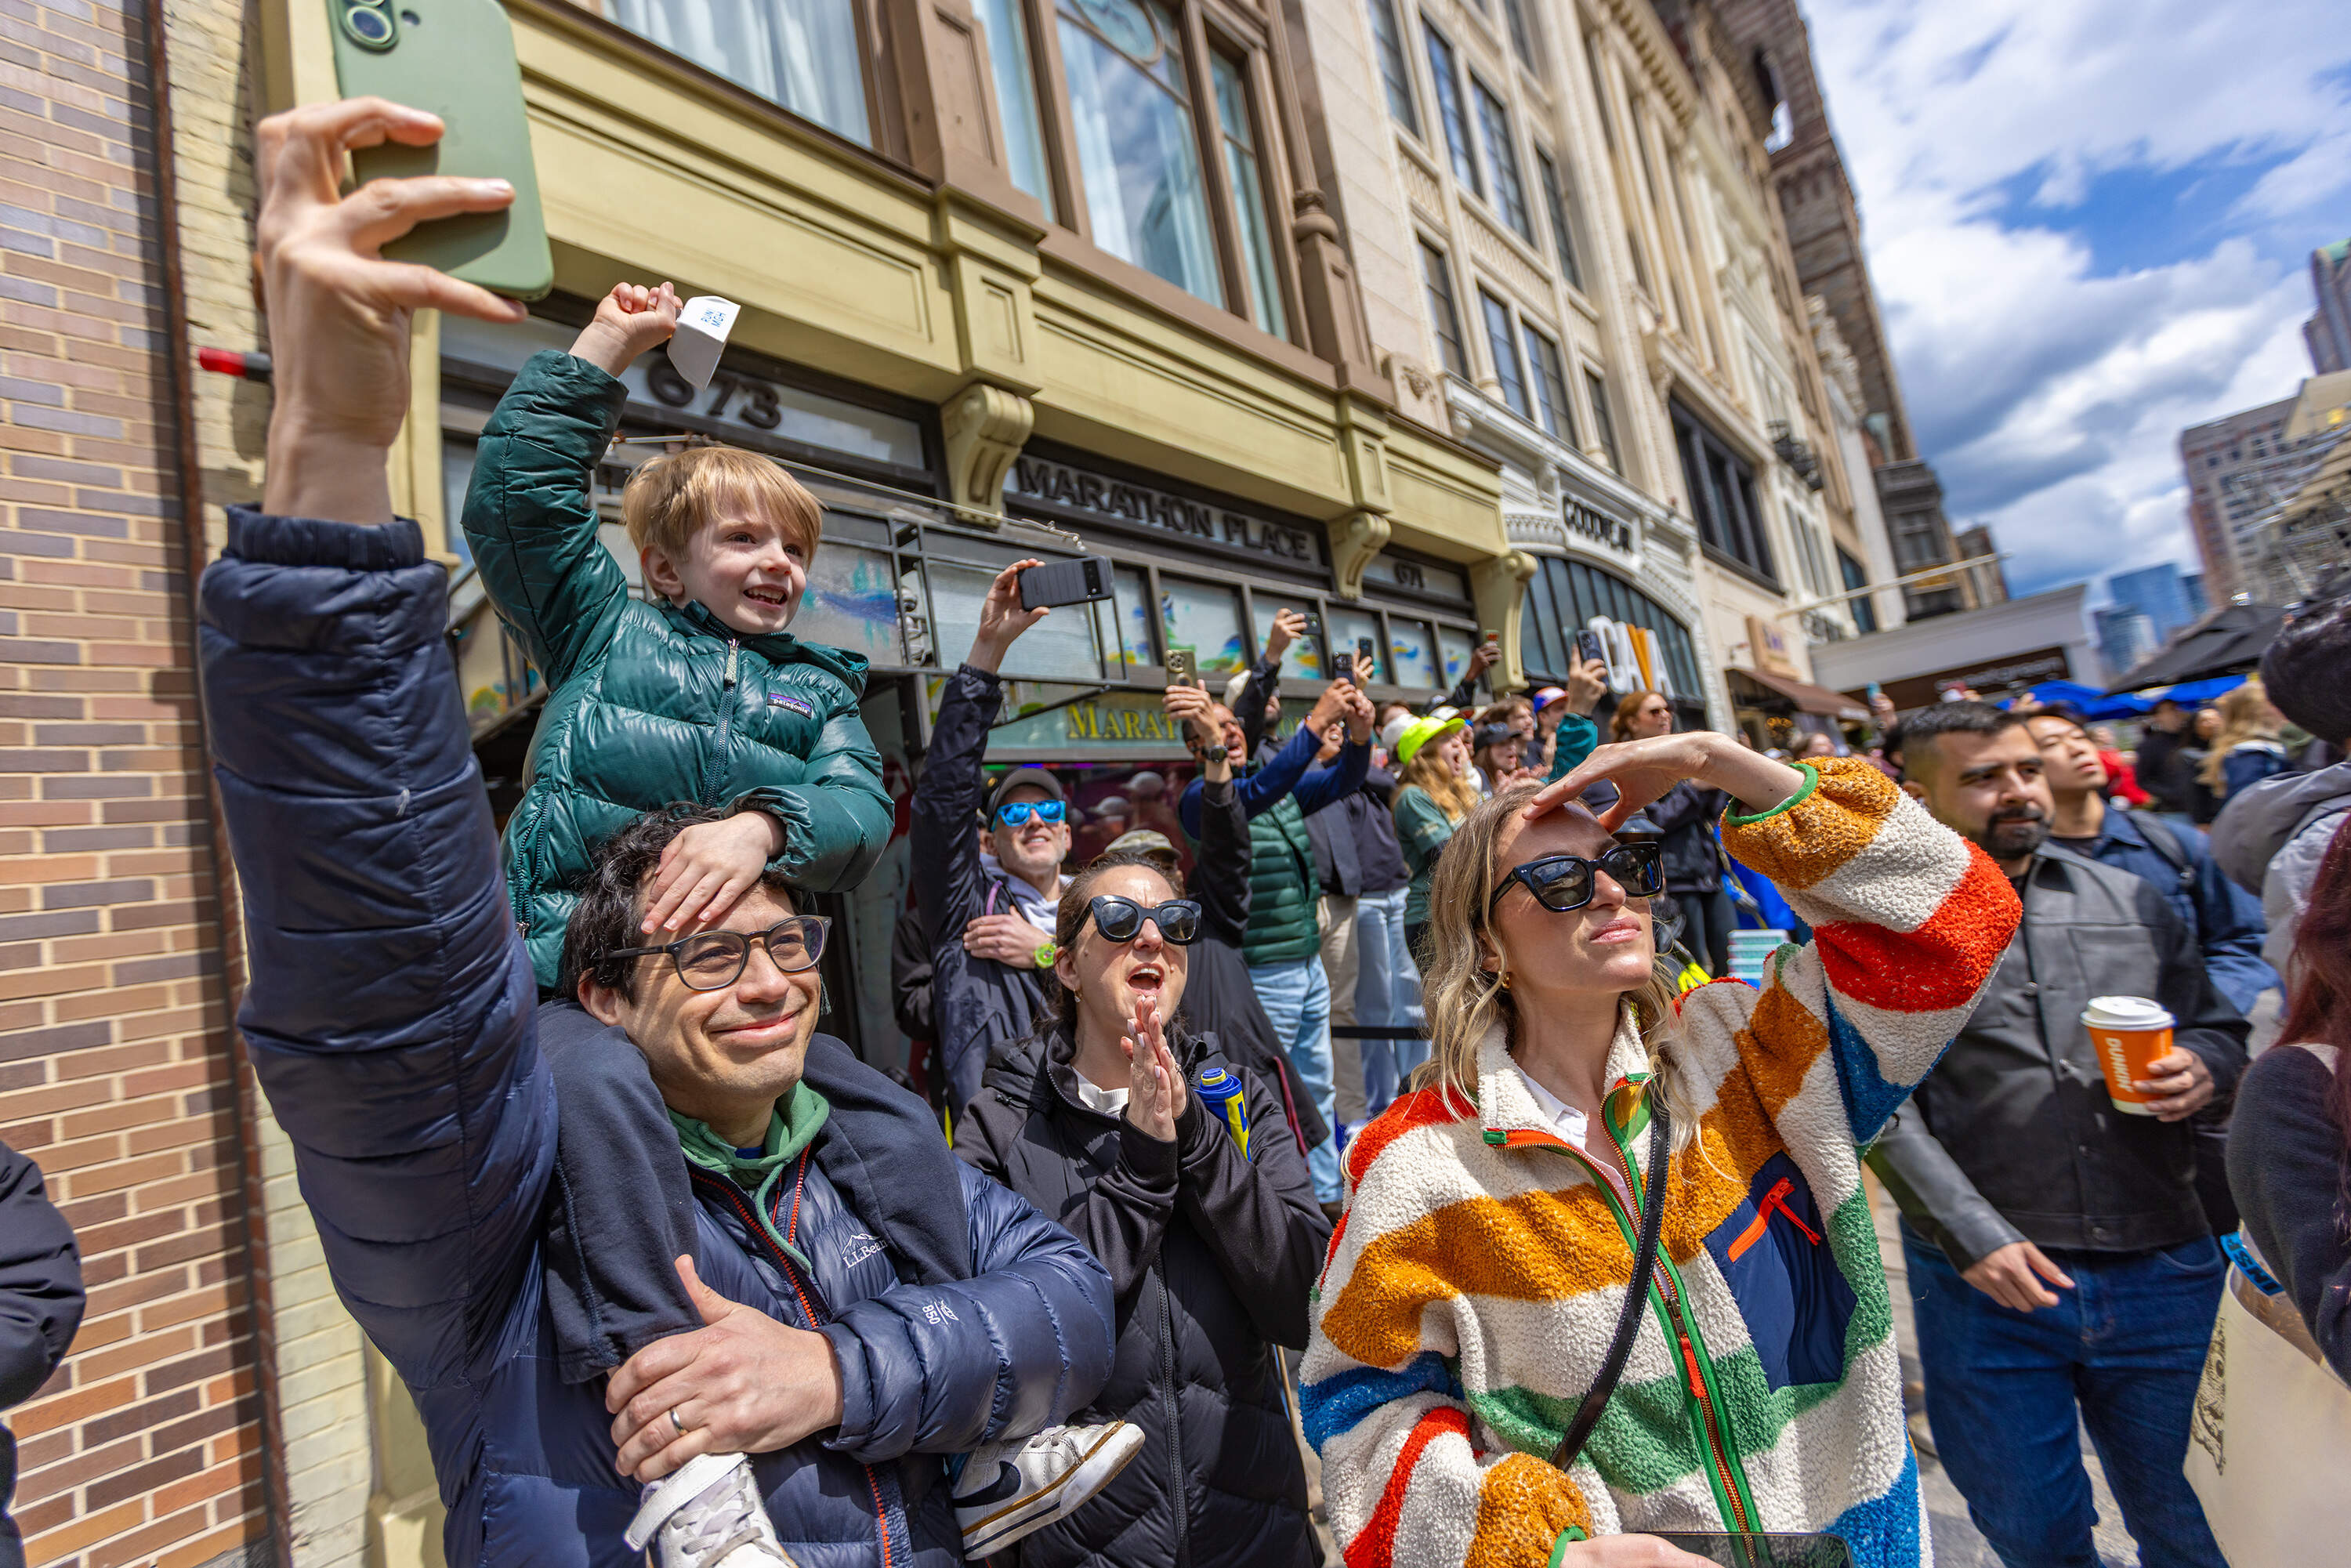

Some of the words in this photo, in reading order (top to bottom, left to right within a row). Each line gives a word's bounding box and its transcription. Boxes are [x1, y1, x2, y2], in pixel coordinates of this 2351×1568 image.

[646, 355, 781, 429] 673
[1016, 457, 1215, 539] MARATHON
[1223, 514, 1311, 561] PLACE
[773, 698, 809, 714] patagonia
[1067, 703, 1177, 740] MARAT
[842, 1239, 888, 1269] L.L.Bean
[922, 1304, 941, 1325] 850
